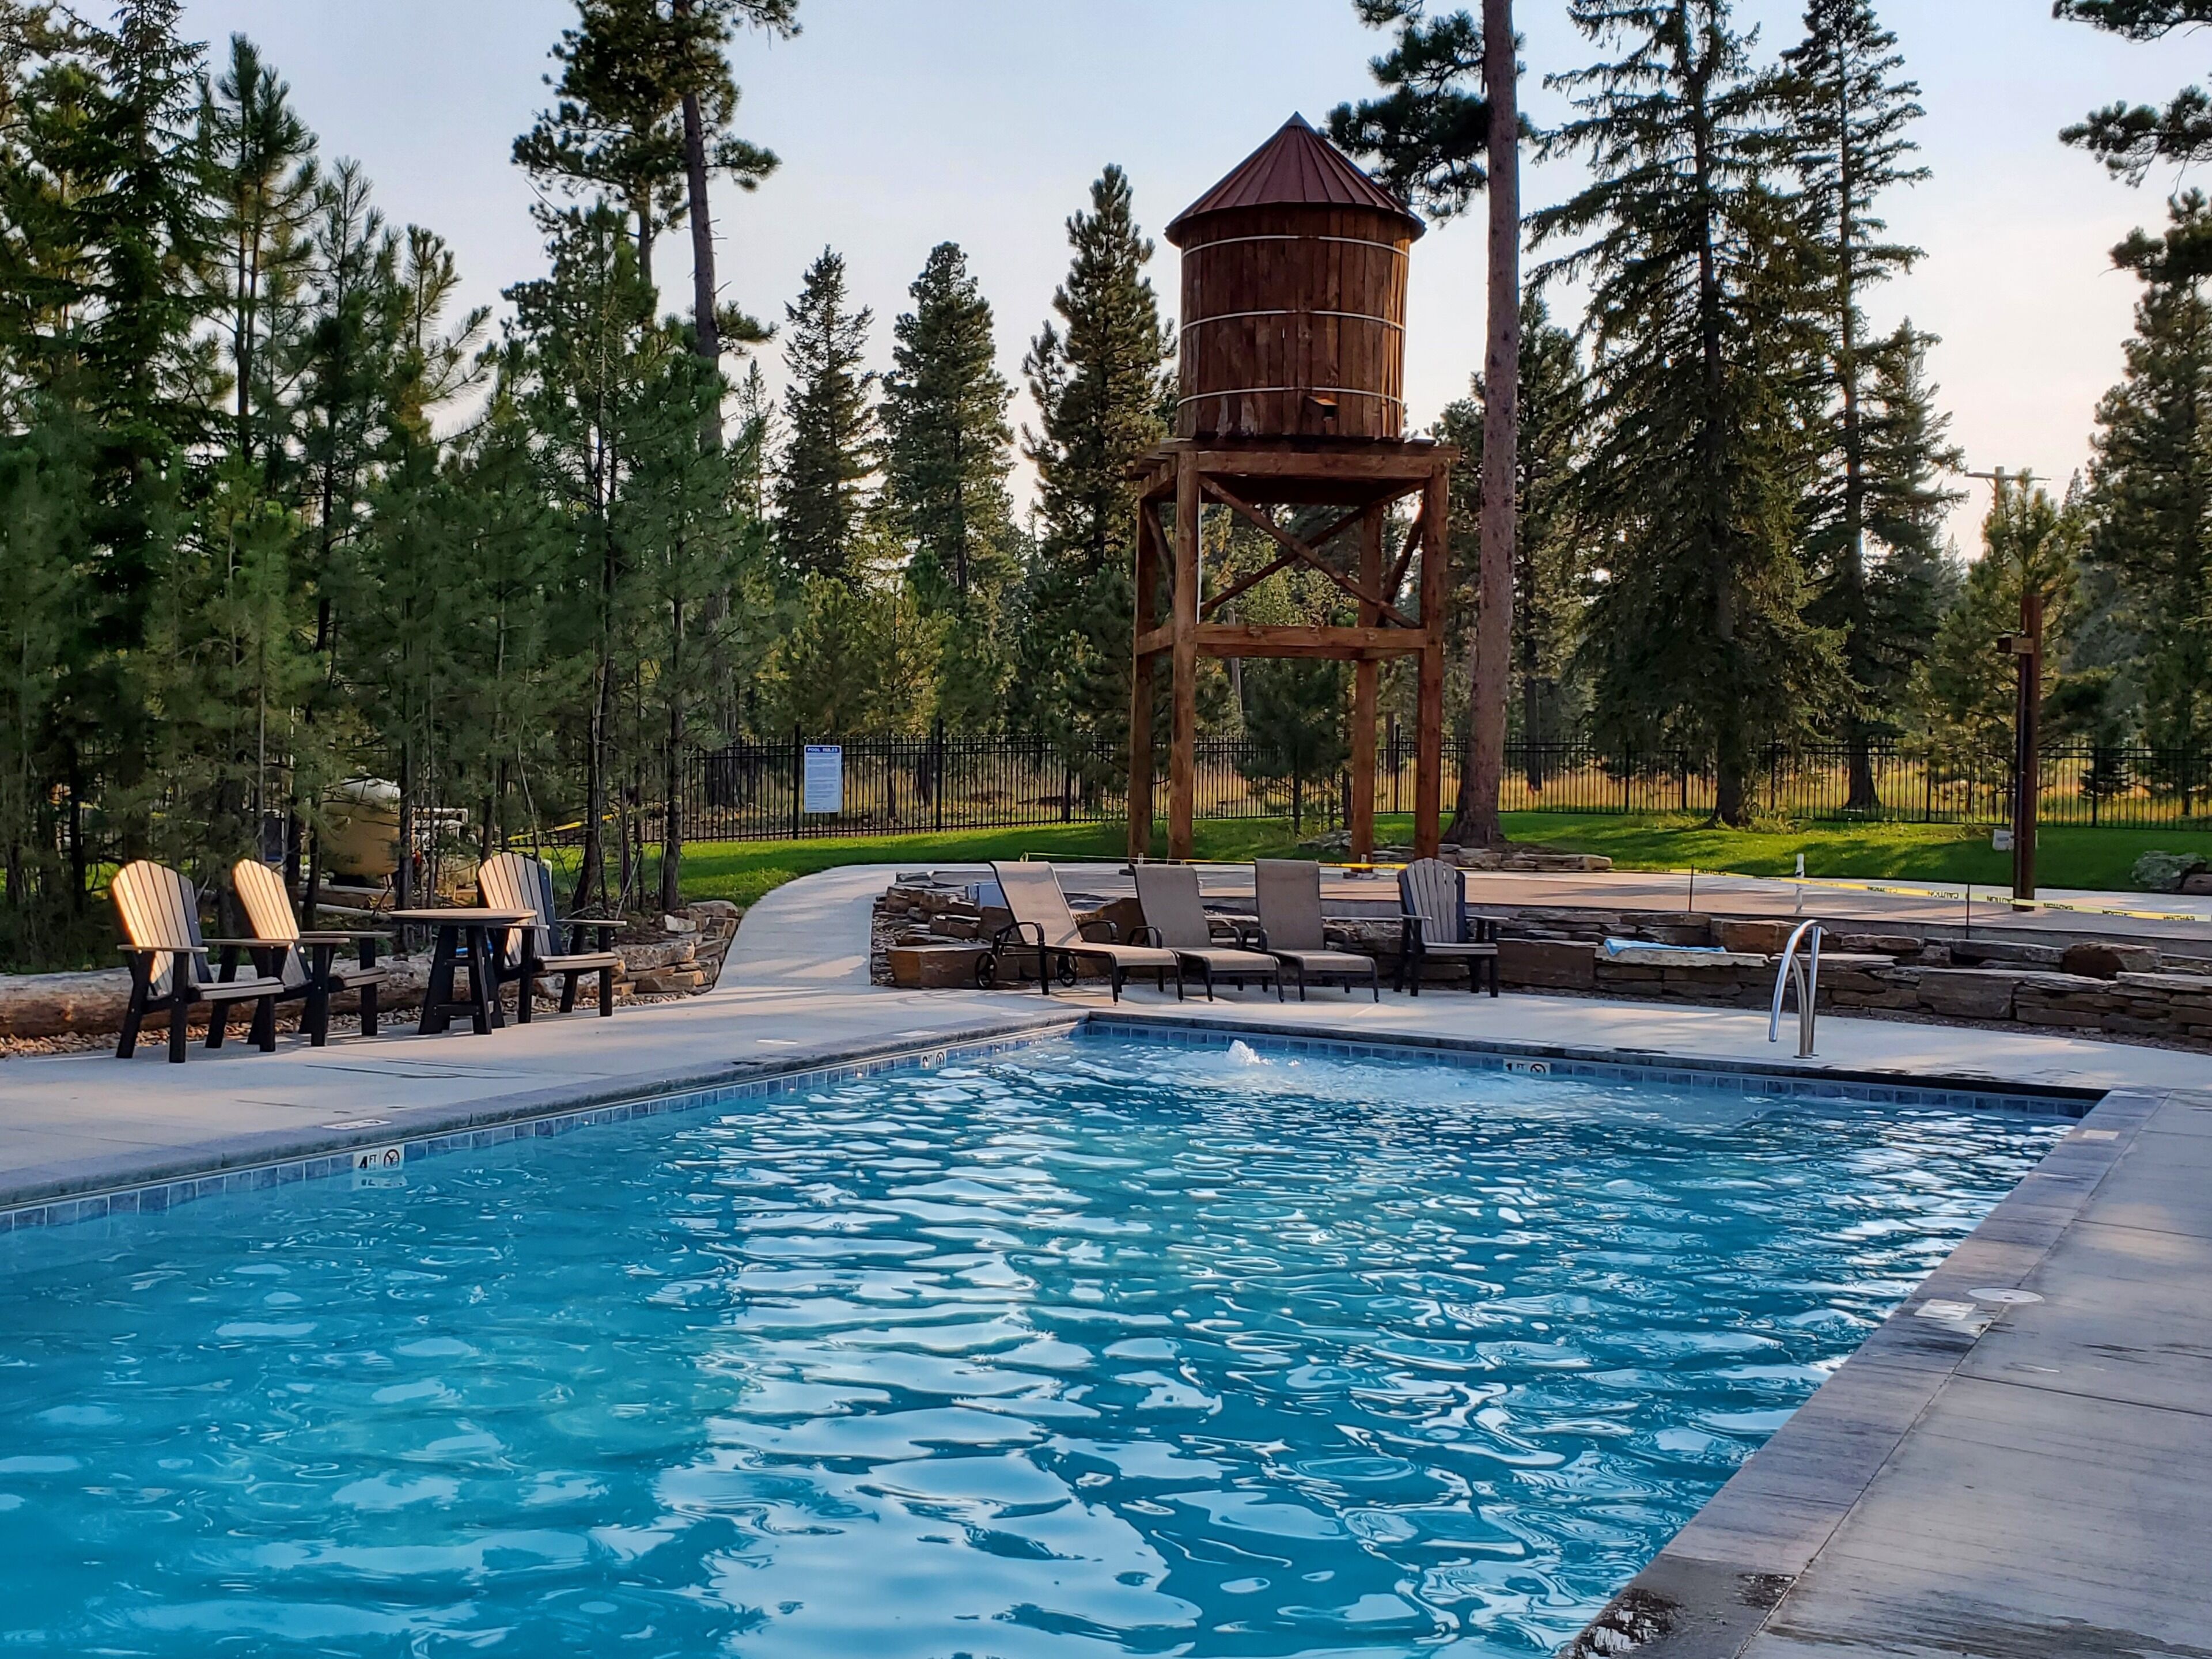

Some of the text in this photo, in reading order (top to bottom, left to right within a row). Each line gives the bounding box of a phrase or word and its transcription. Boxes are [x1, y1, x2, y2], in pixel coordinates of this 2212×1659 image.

[1927, 891, 1959, 899] CAUTION
[358, 1154, 377, 1169] 4 FT
